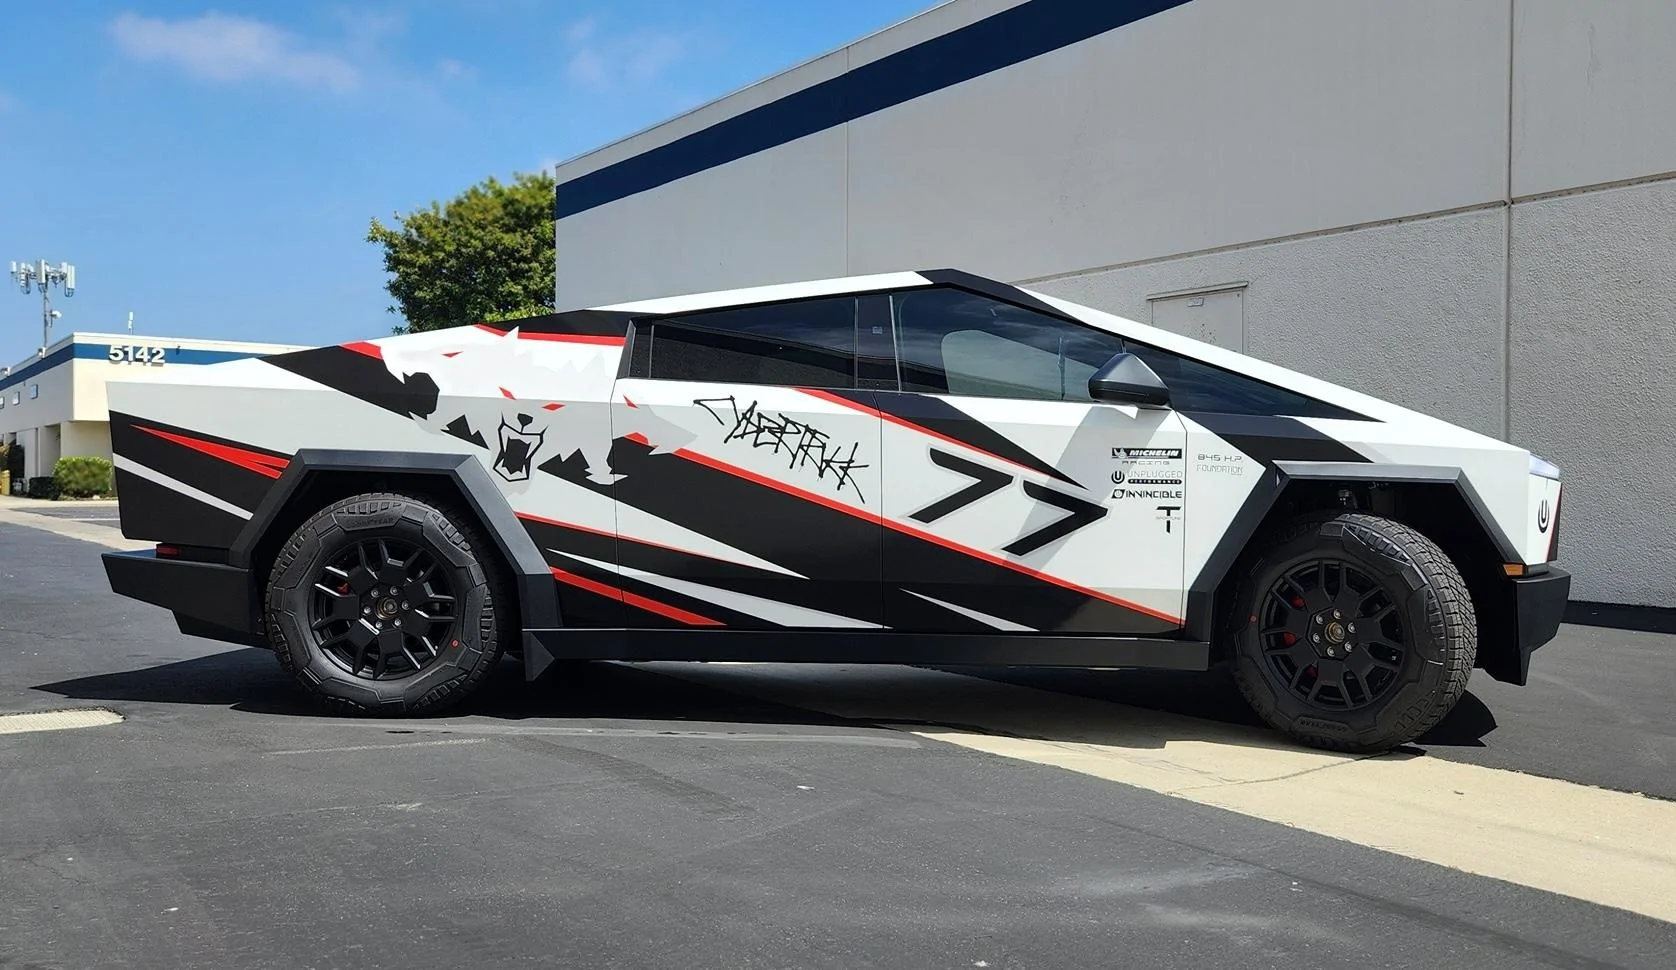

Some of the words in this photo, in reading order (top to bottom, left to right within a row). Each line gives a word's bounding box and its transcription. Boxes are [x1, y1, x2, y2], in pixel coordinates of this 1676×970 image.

[109, 344, 166, 364] 5142
[1129, 449, 1180, 457] MICHELIN
[1197, 453, 1221, 462] 845
[1196, 464, 1243, 473] FOUNDATION
[1126, 490, 1183, 499] INVINCIBLE
